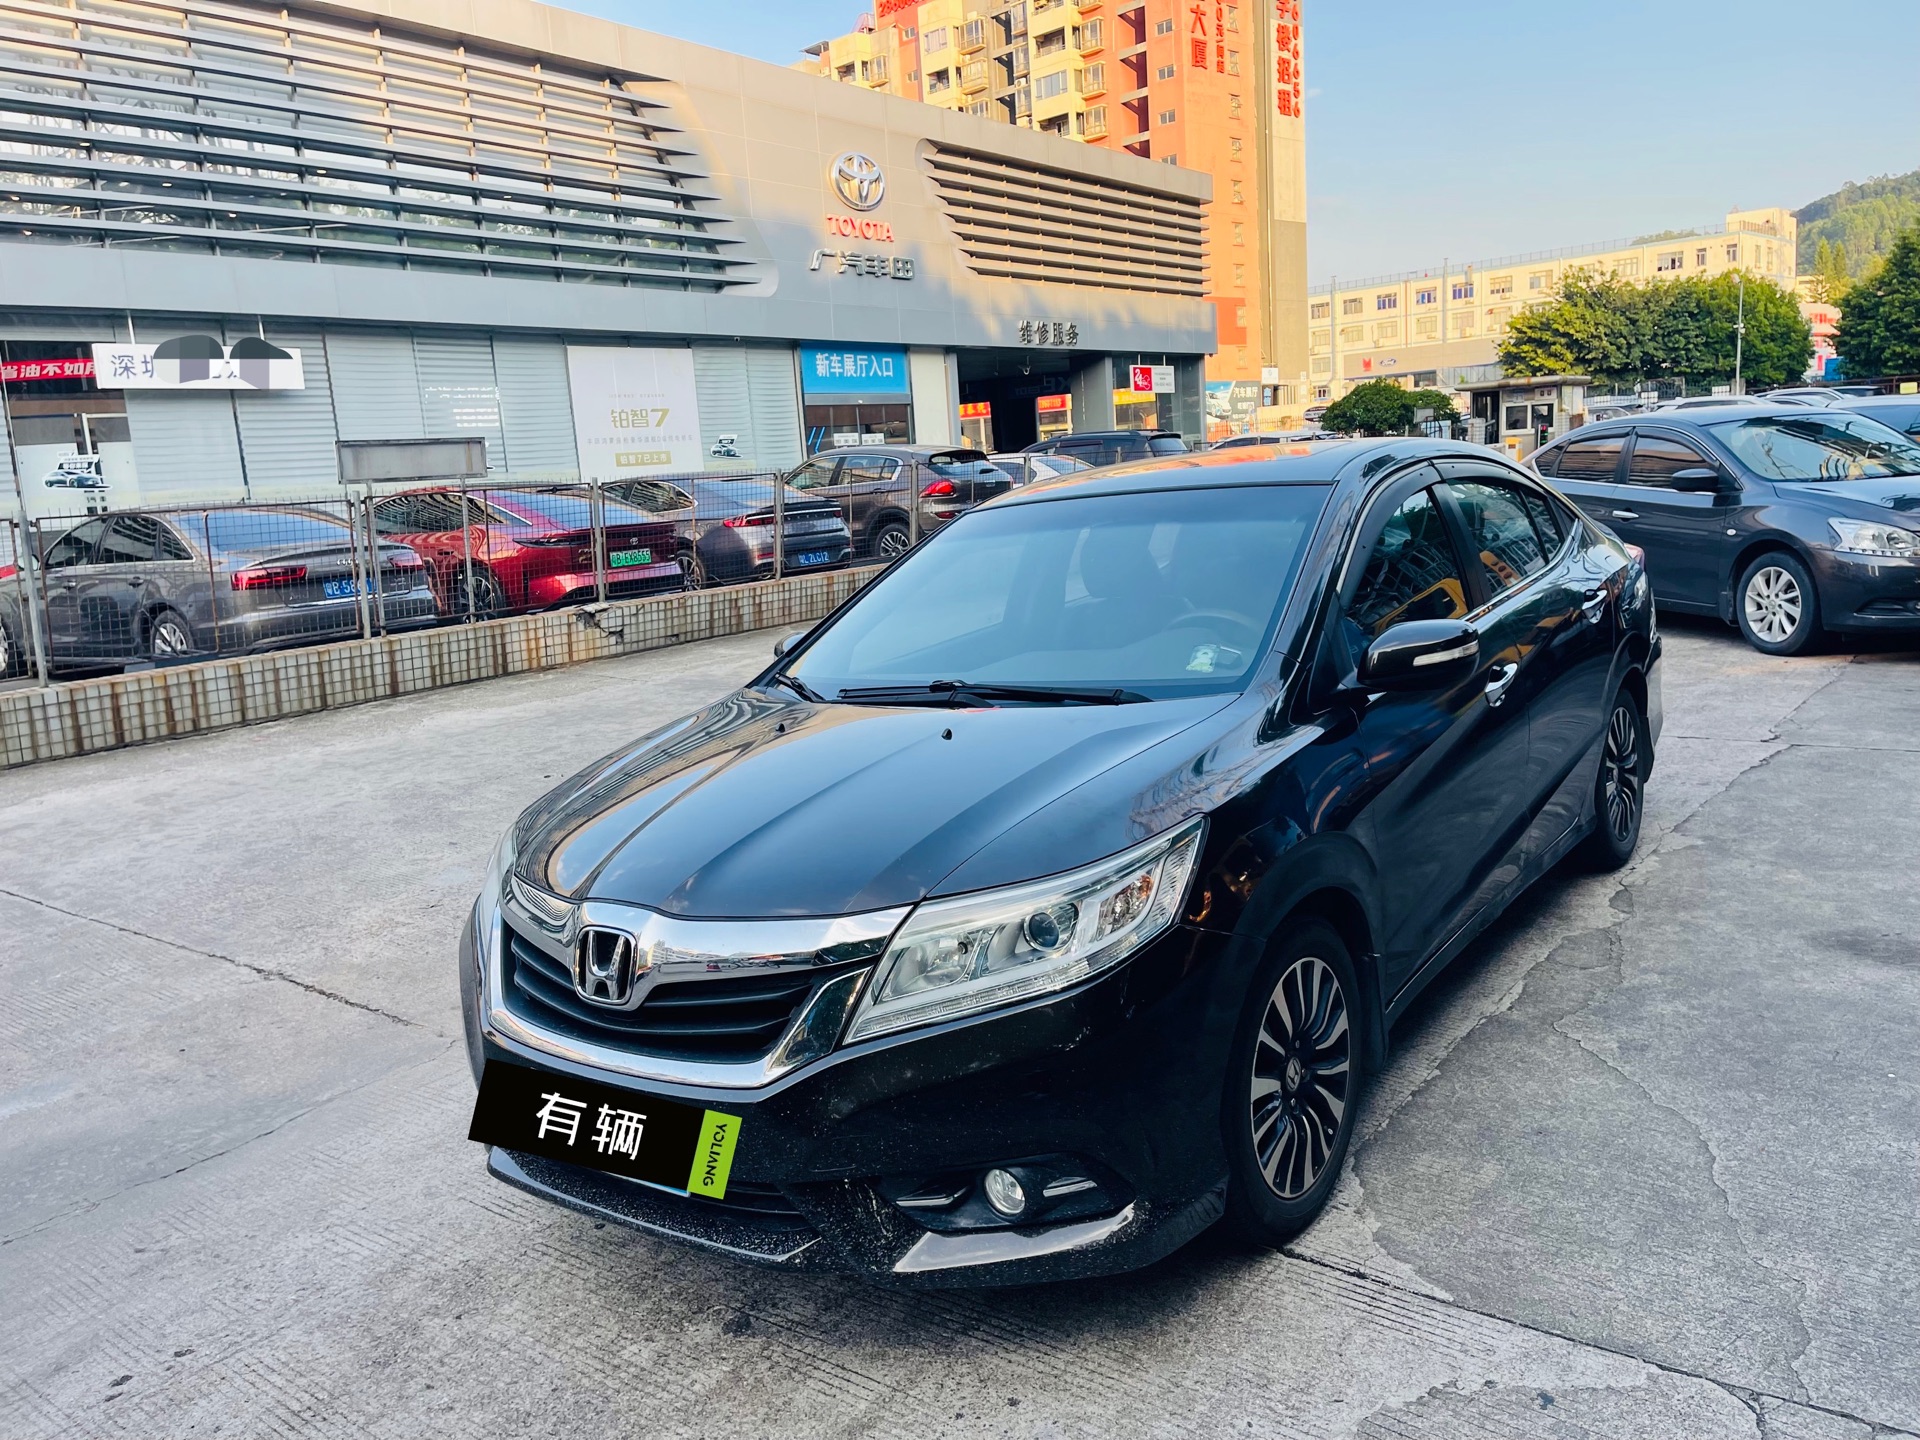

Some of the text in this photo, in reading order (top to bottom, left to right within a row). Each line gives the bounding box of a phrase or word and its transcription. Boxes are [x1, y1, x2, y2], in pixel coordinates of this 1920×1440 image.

[1189, 4, 1208, 70] 大厦
[1291, 0, 1301, 119] 606656
[826, 214, 895, 242] TOYOTA
[810, 248, 915, 280] 广汽丰田
[1018, 320, 1079, 346] 维修服务
[815, 352, 894, 378] 新车展厅入口
[1233, 386, 1259, 399] 汽车展厅
[610, 408, 670, 429] 铂智7
[619, 453, 668, 465] 铂智7已上市
